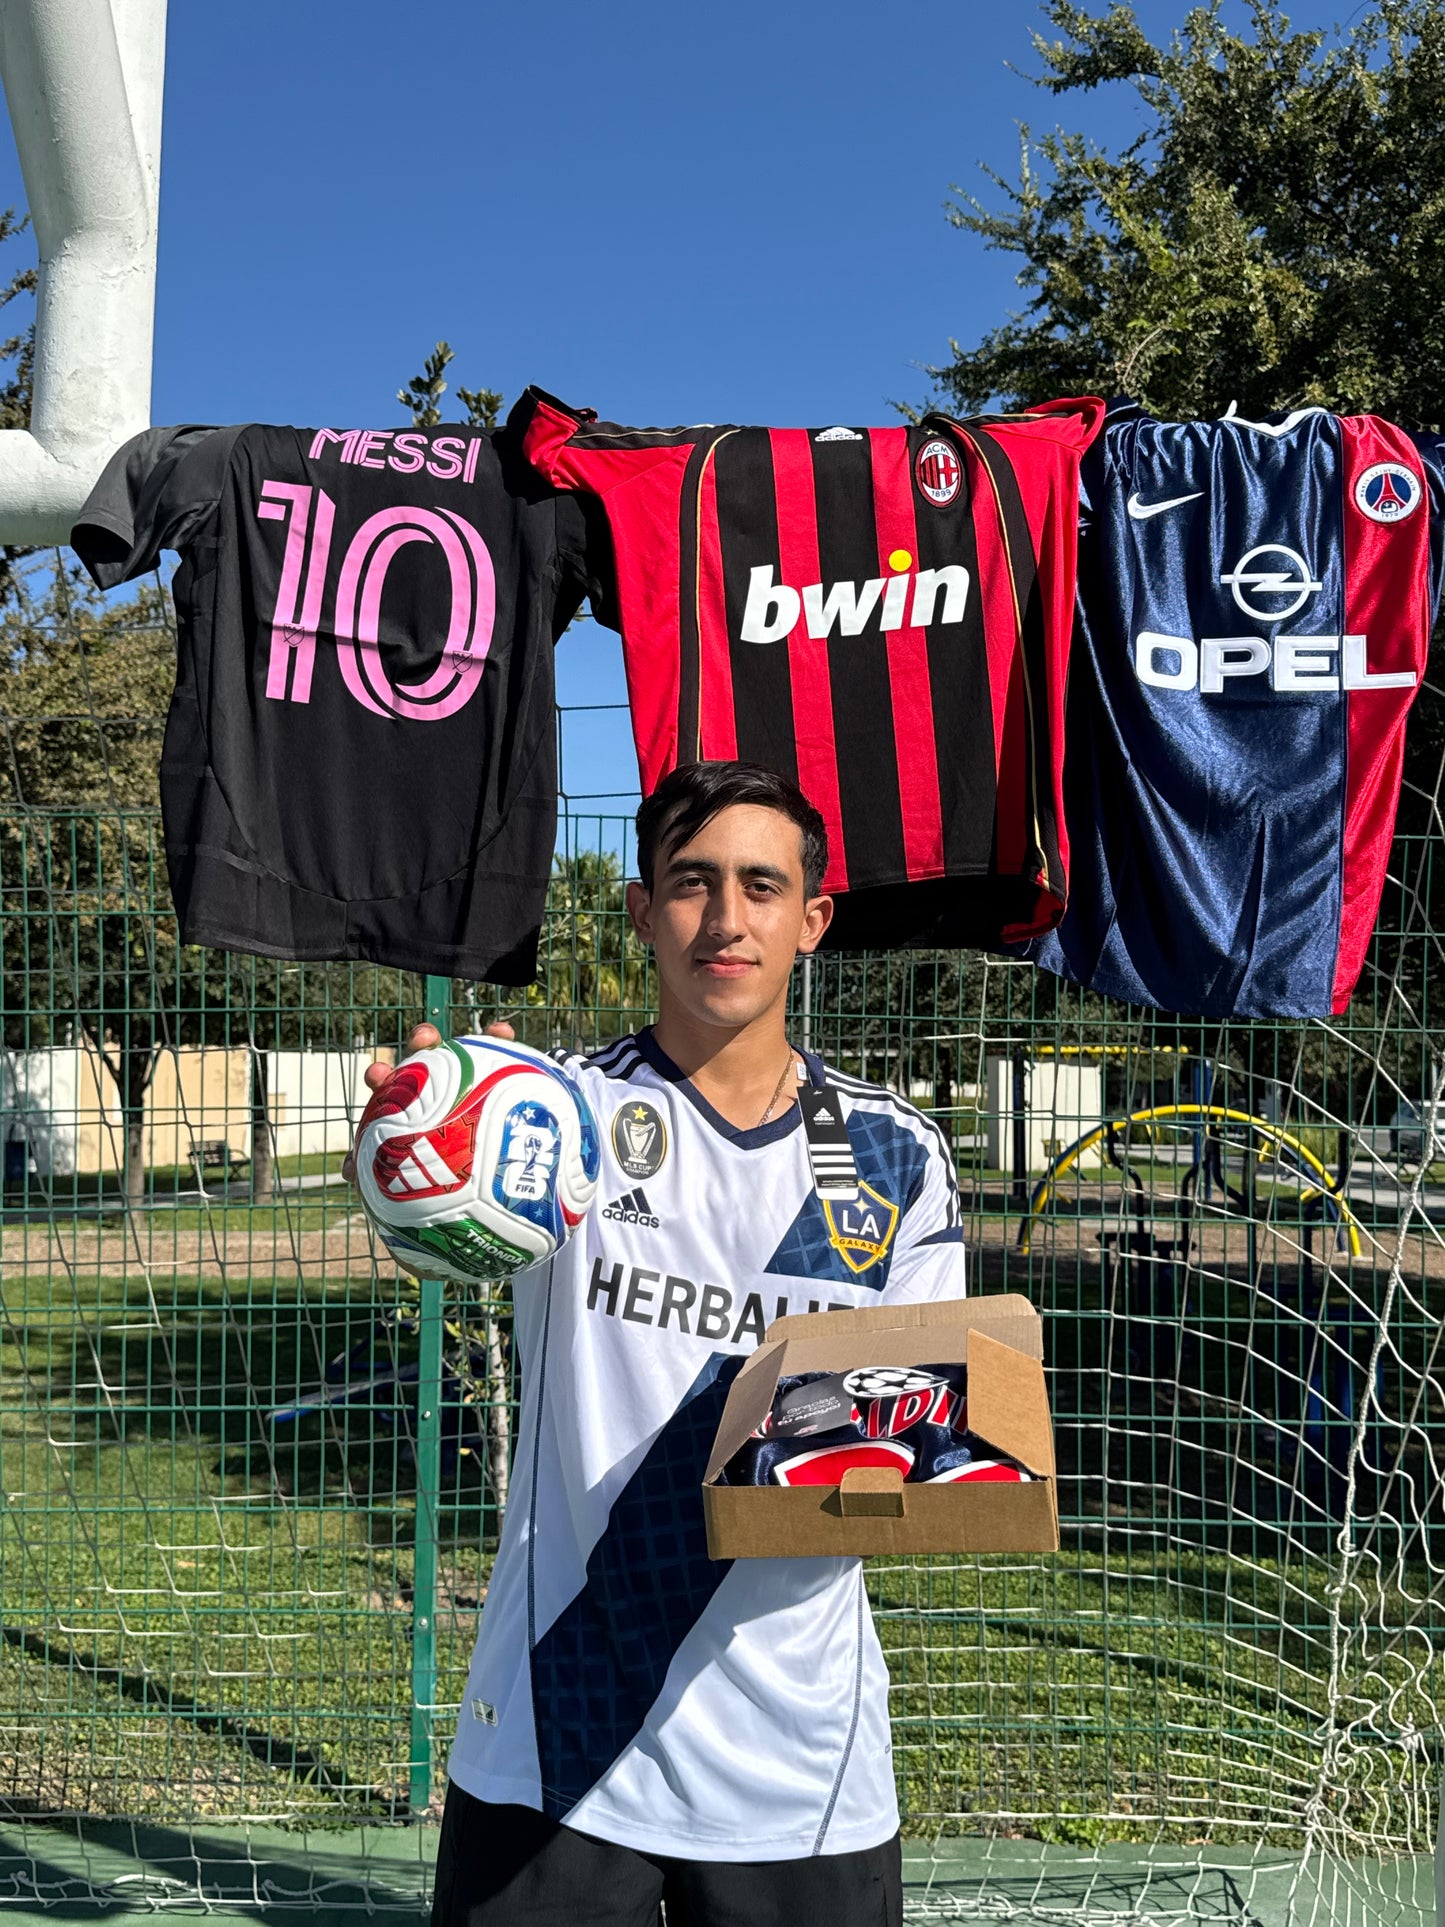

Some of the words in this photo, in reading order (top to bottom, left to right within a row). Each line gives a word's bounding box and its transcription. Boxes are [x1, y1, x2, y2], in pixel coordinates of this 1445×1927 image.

[814, 433, 863, 442] adidas
[925, 444, 950, 457] ACM
[308, 428, 483, 483] MESSI
[931, 488, 952, 498] 1899
[257, 479, 496, 721] 10
[740, 549, 970, 644] bwin
[1135, 631, 1417, 693] OPEL
[638, 1164, 652, 1172] CUP
[515, 1183, 536, 1195] FIFA
[601, 1206, 660, 1229] adidas
[842, 1209, 881, 1239] LA
[466, 1228, 525, 1265] TRIONDA
[838, 1238, 881, 1252] GALAXY
[586, 1256, 855, 1347] HERBA
